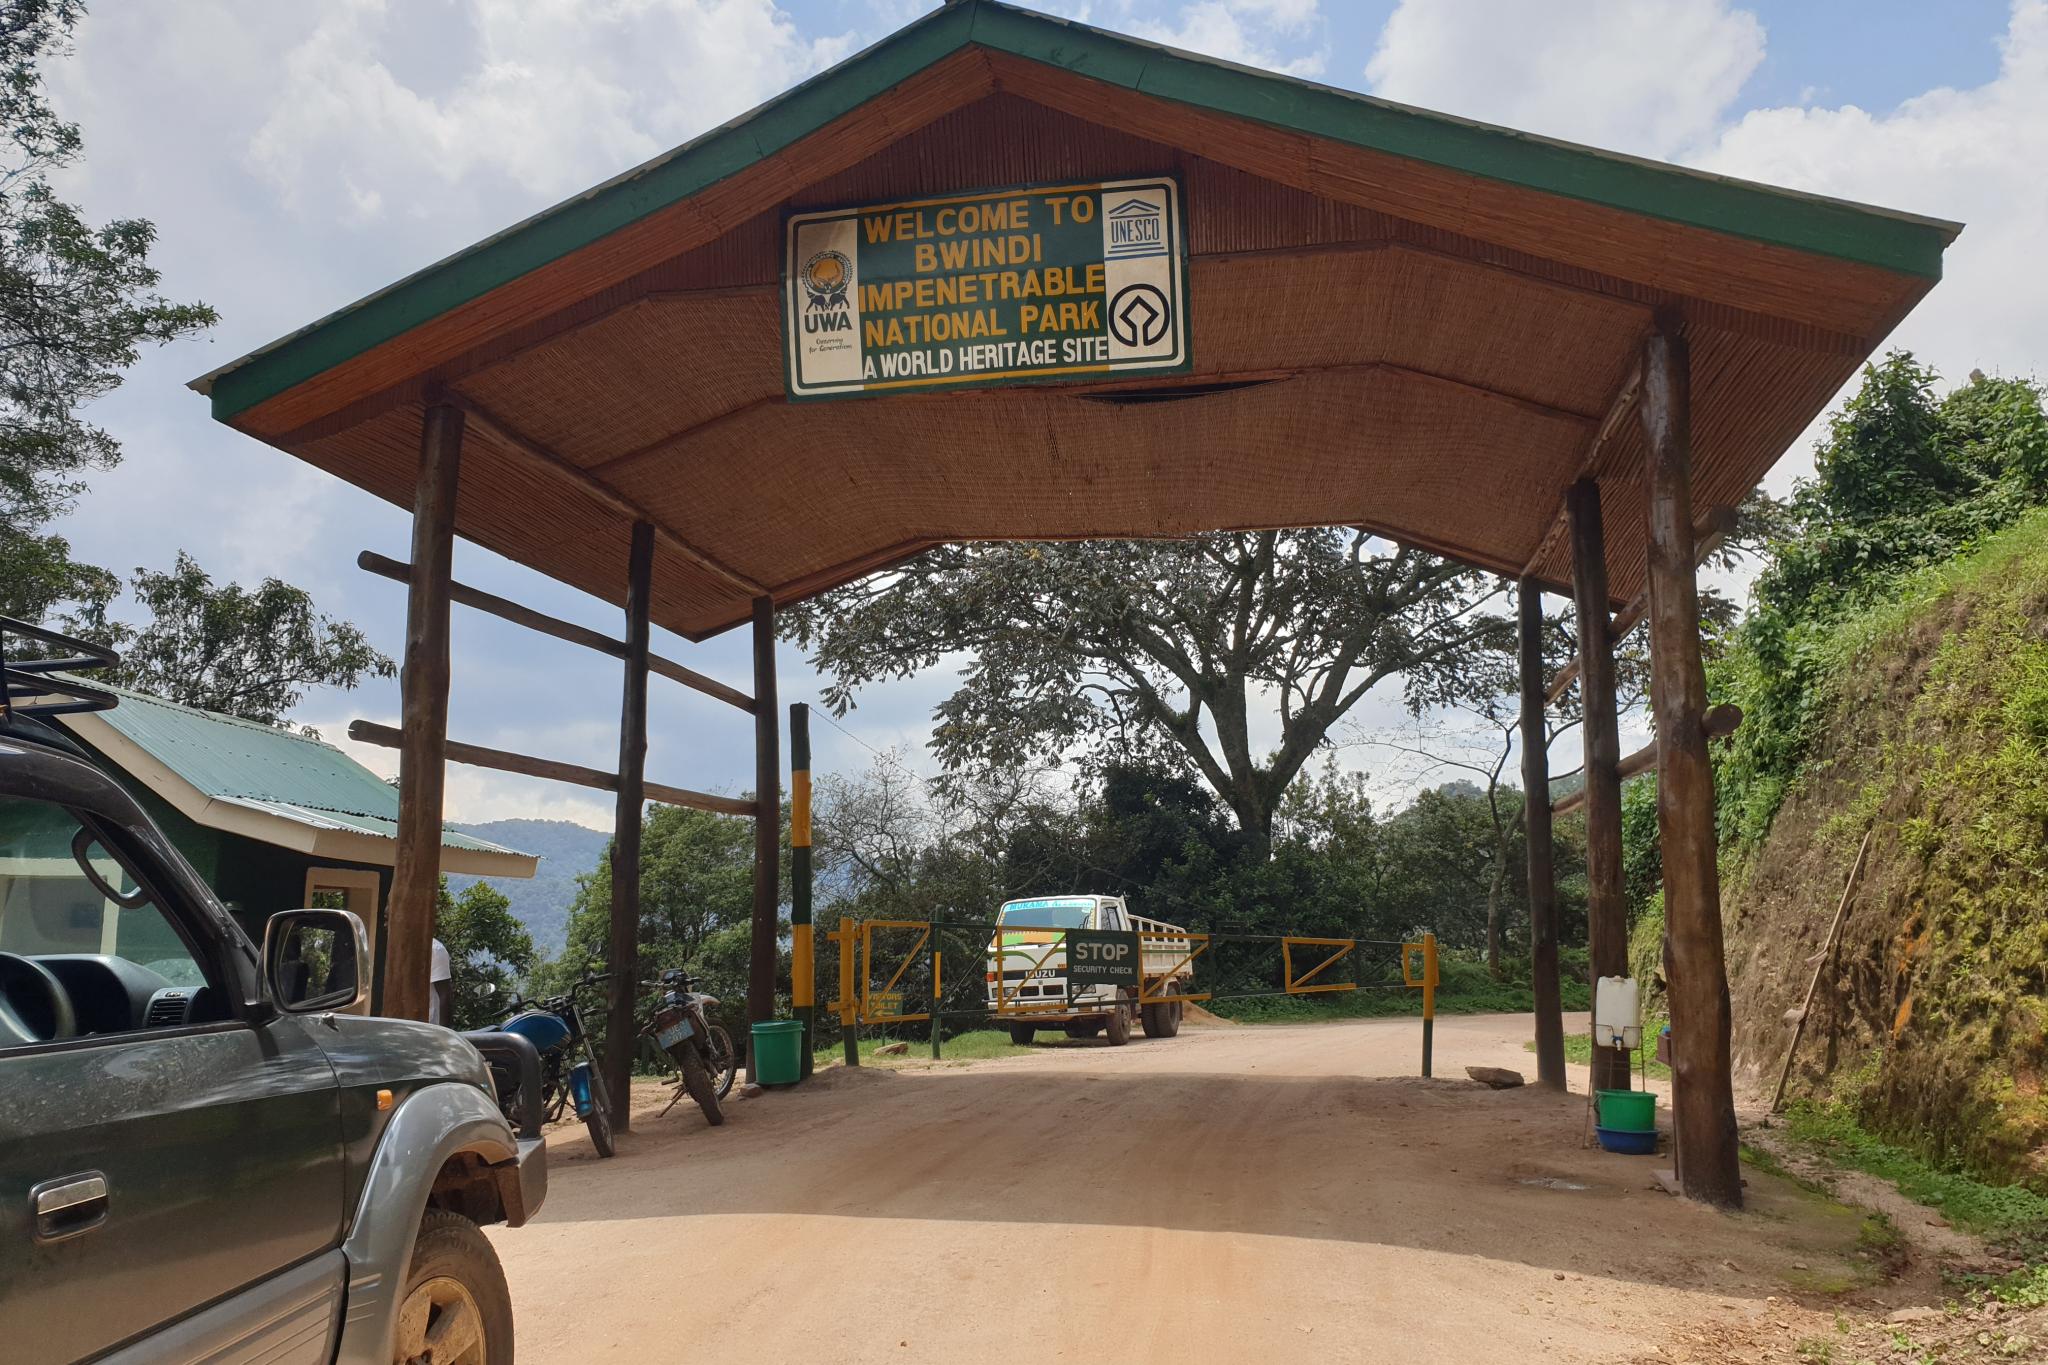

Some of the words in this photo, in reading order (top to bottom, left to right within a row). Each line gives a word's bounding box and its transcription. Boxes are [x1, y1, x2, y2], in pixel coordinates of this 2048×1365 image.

[864, 199, 1029, 244] WELCOME
[1045, 195, 1094, 225] TO
[1111, 218, 1160, 244] UNESCO
[915, 233, 1042, 273] BWINDI
[858, 264, 1105, 313] IMPENETRABLE
[804, 311, 853, 334] UWA
[865, 308, 1007, 348] NATIONAL
[1020, 300, 1100, 334] PARK
[863, 355, 878, 380] A
[880, 346, 953, 377] WORLD
[959, 339, 1057, 371] HERITAGE
[1062, 335, 1108, 364] SITE
[1073, 965, 1107, 974] SECURITY
[1109, 966, 1133, 975] CHECK
[1075, 942, 1129, 960] STOP
